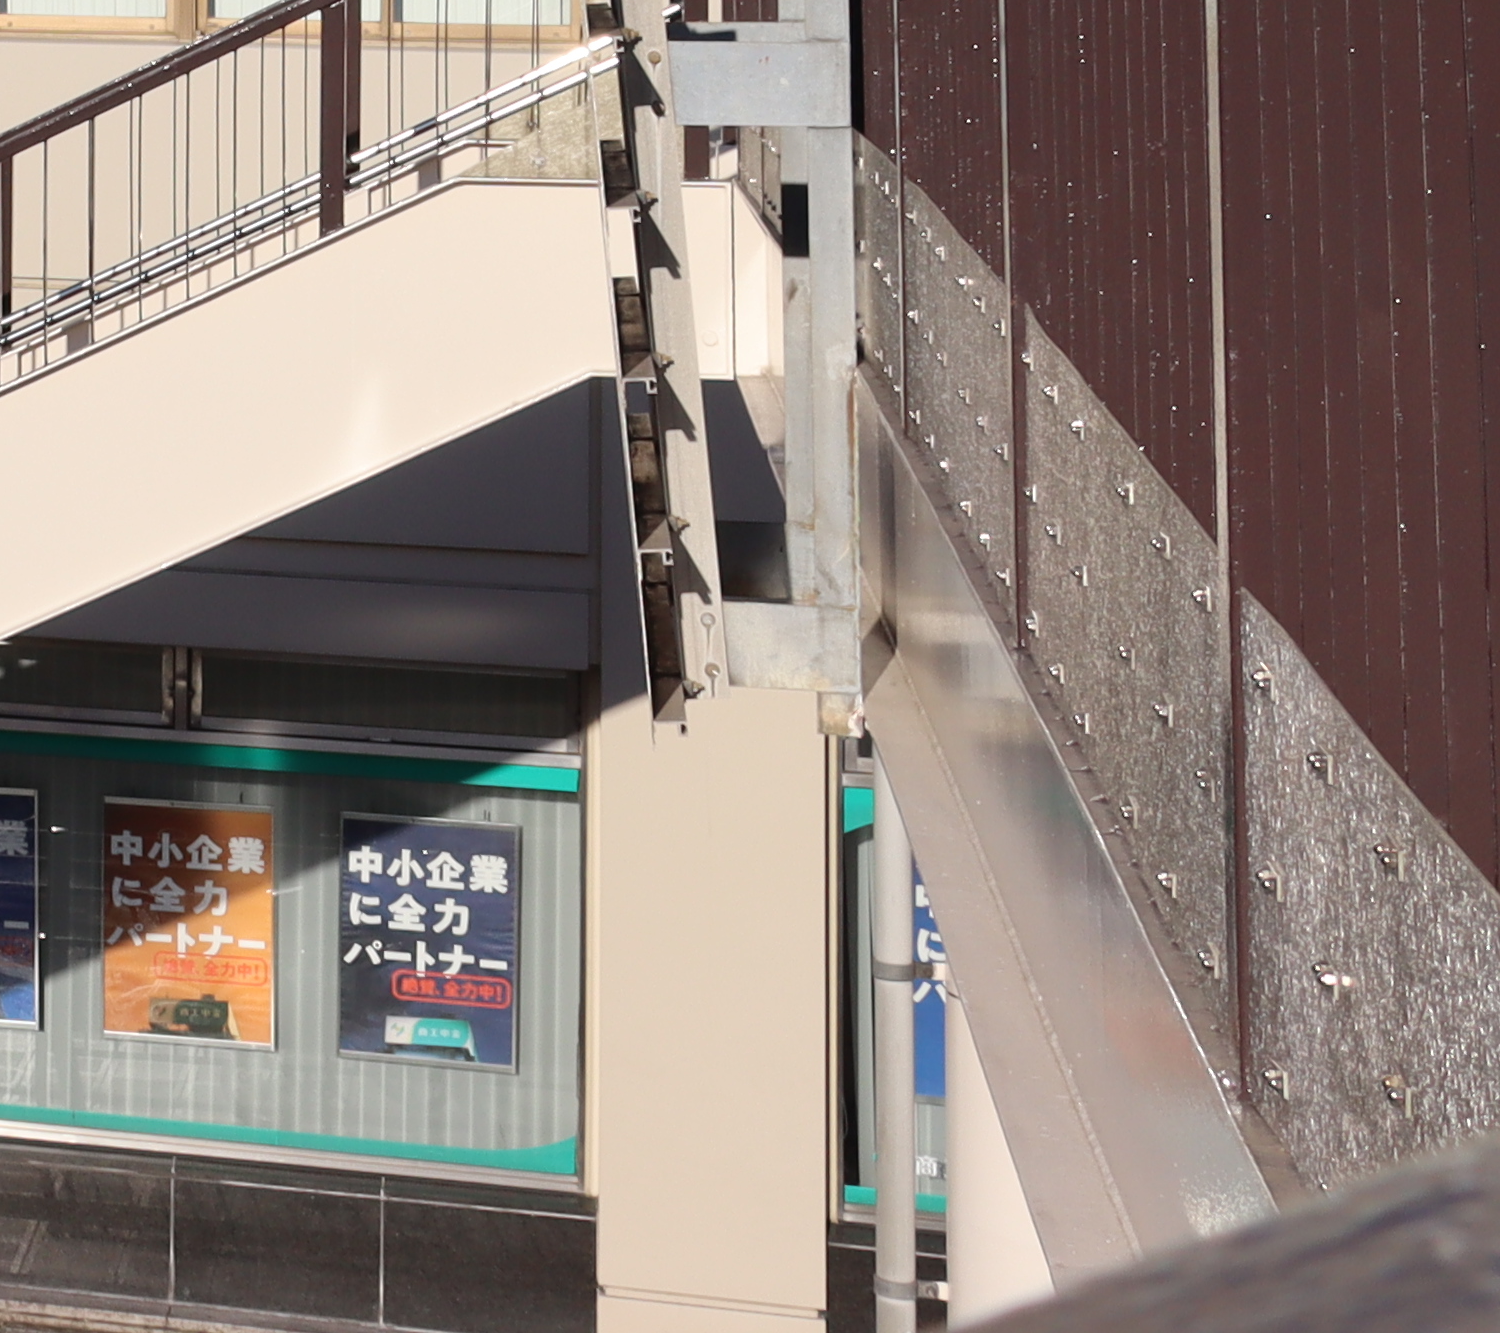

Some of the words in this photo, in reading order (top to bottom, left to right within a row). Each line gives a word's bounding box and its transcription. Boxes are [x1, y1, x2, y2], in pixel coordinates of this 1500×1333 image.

[110, 828, 266, 875] 中小企業
[348, 845, 510, 895] 中小企業
[111, 875, 229, 917] に全力
[348, 891, 471, 937] に全力
[106, 921, 267, 959] パートナー
[343, 939, 509, 979] パートナー
